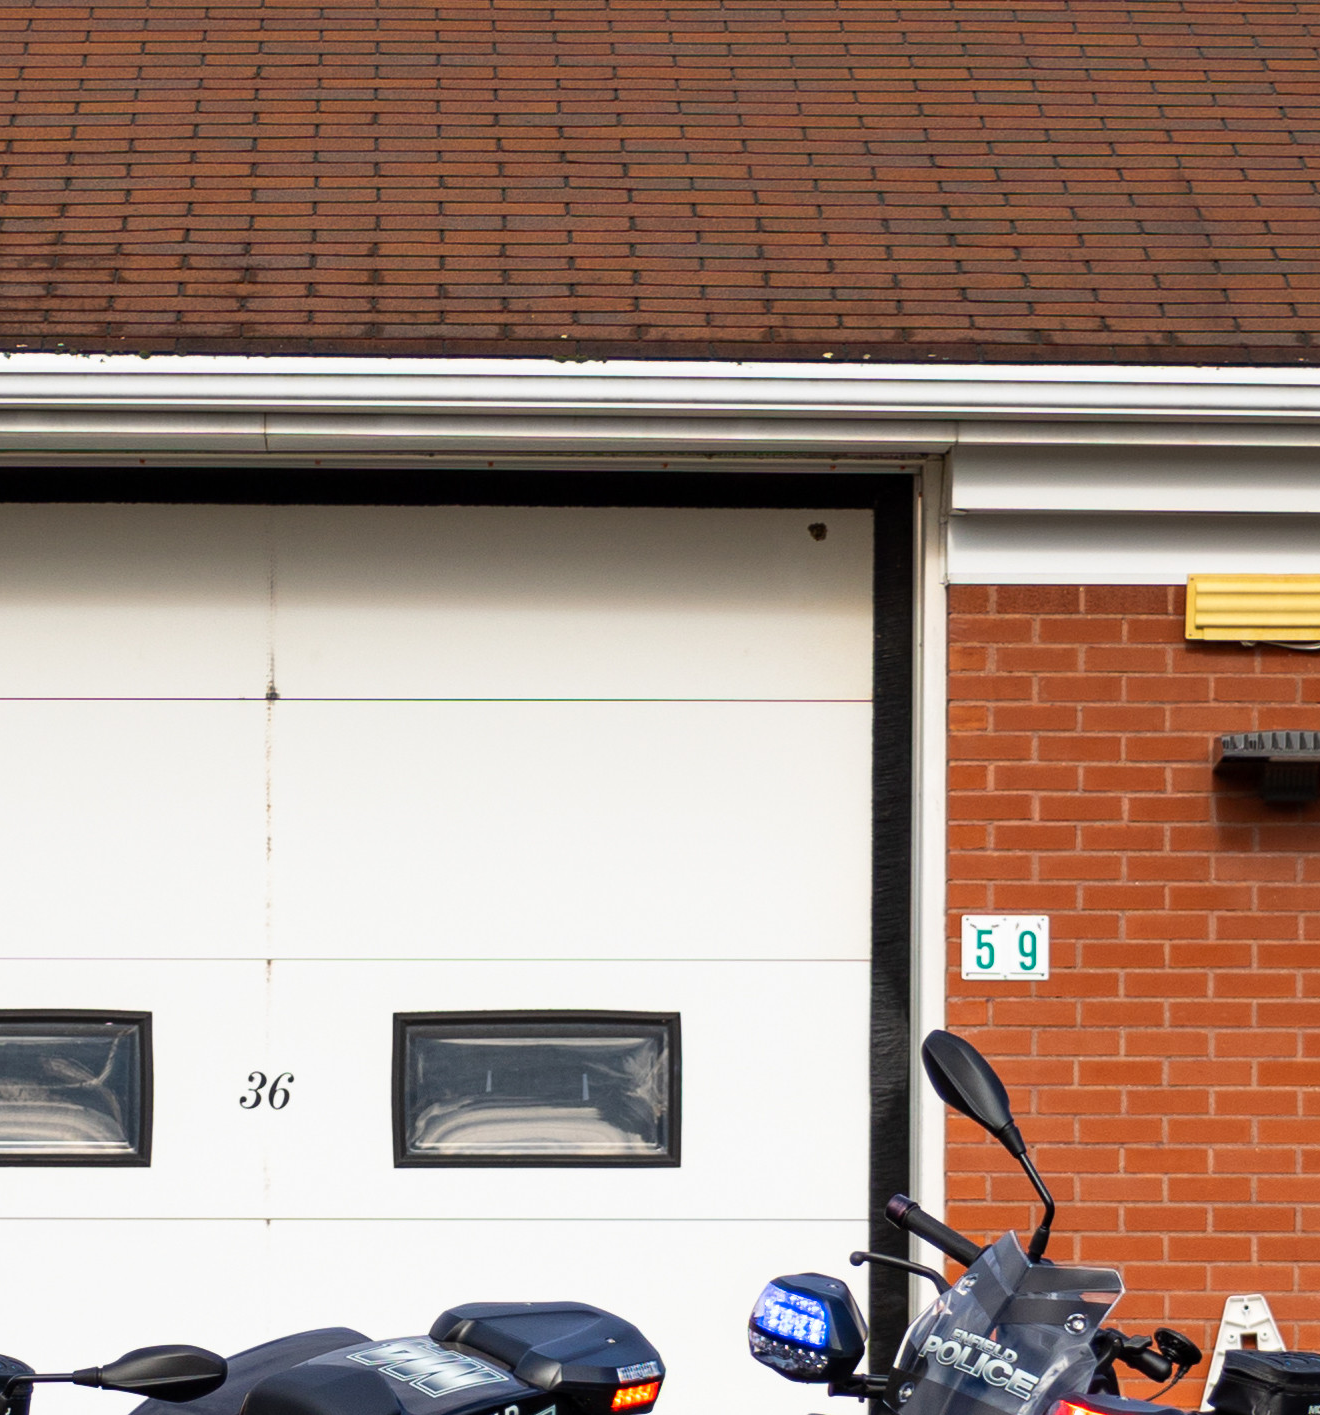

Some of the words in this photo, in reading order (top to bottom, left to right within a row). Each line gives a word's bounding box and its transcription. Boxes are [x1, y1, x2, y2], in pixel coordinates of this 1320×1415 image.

[976, 929, 1037, 971] 59
[239, 1071, 295, 1110] 36
[952, 1328, 1018, 1363] ENFIELD
[918, 1334, 1040, 1401] POLICE
